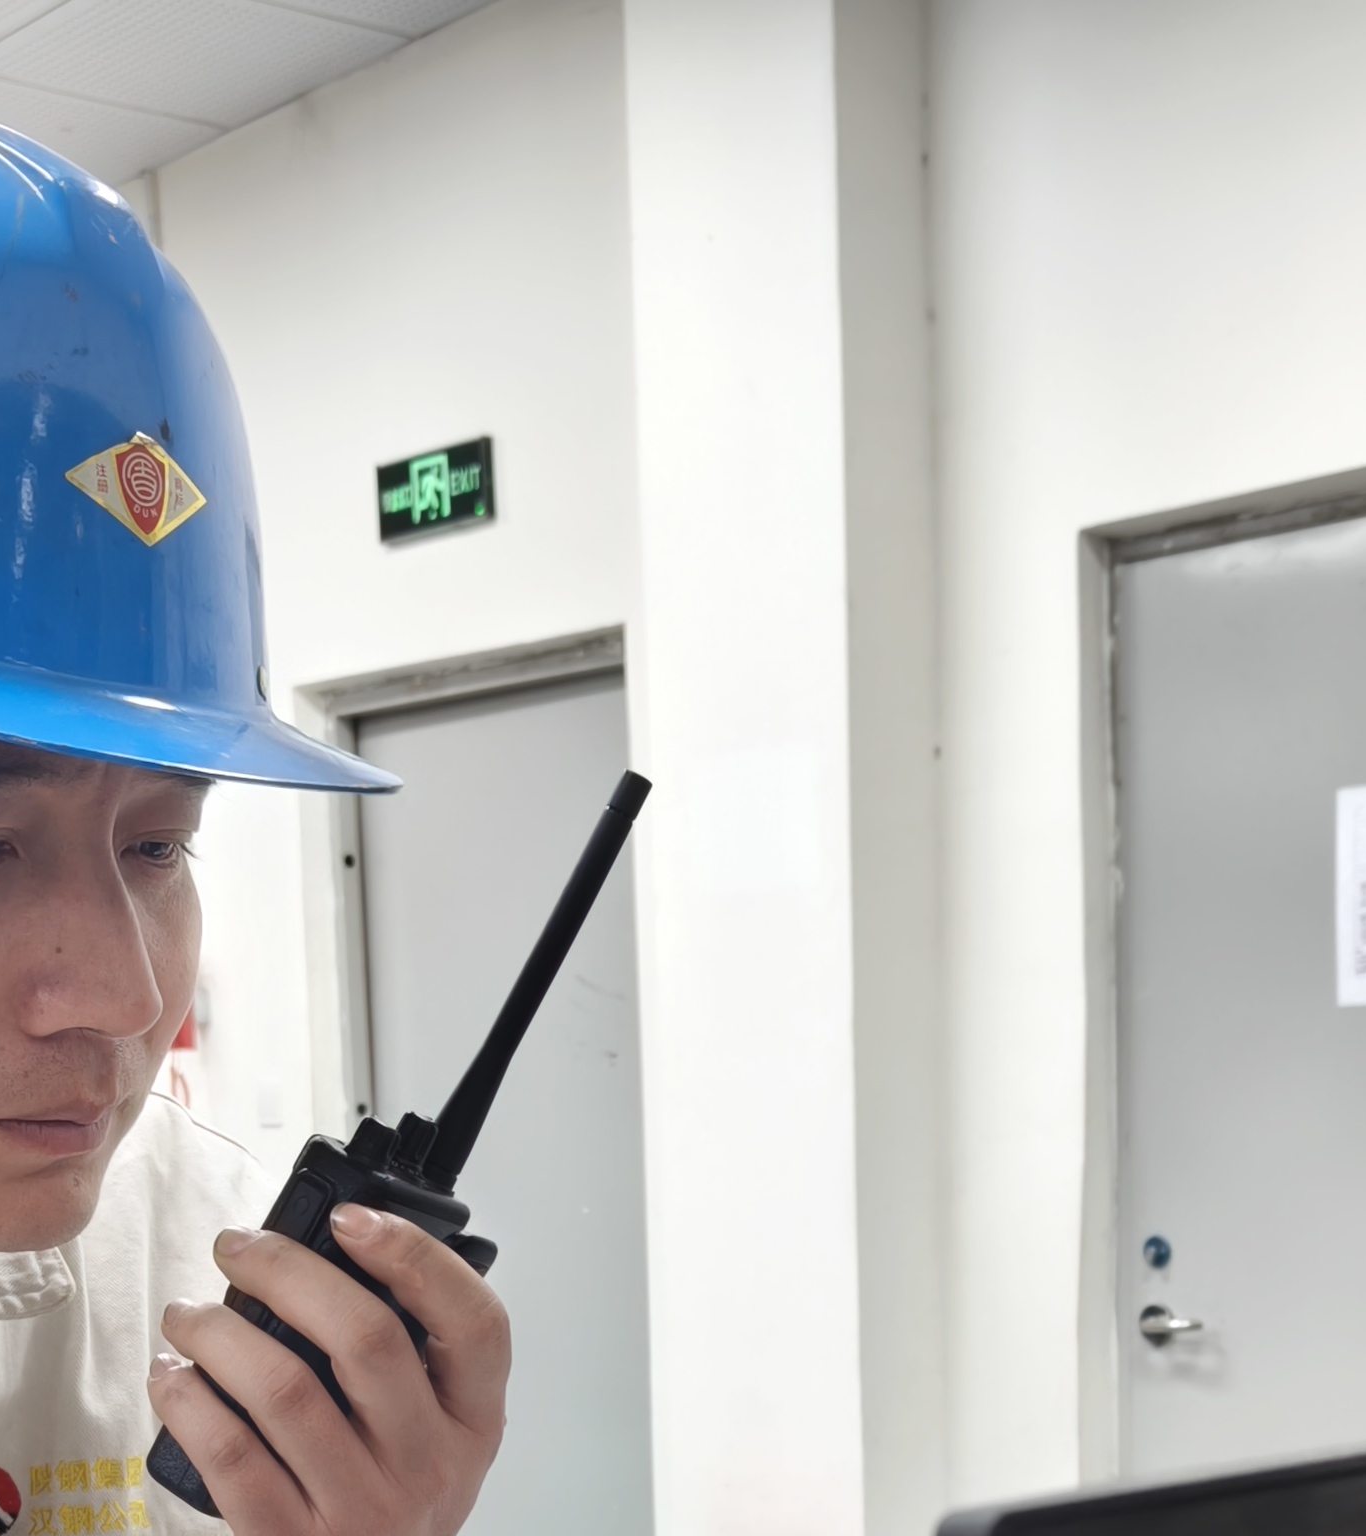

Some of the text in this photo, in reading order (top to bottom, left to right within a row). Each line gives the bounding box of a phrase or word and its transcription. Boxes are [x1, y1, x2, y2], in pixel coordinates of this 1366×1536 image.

[450, 463, 481, 496] EXIT
[133, 504, 158, 518] DUN
[28, 1500, 150, 1536] 汉钢公司
